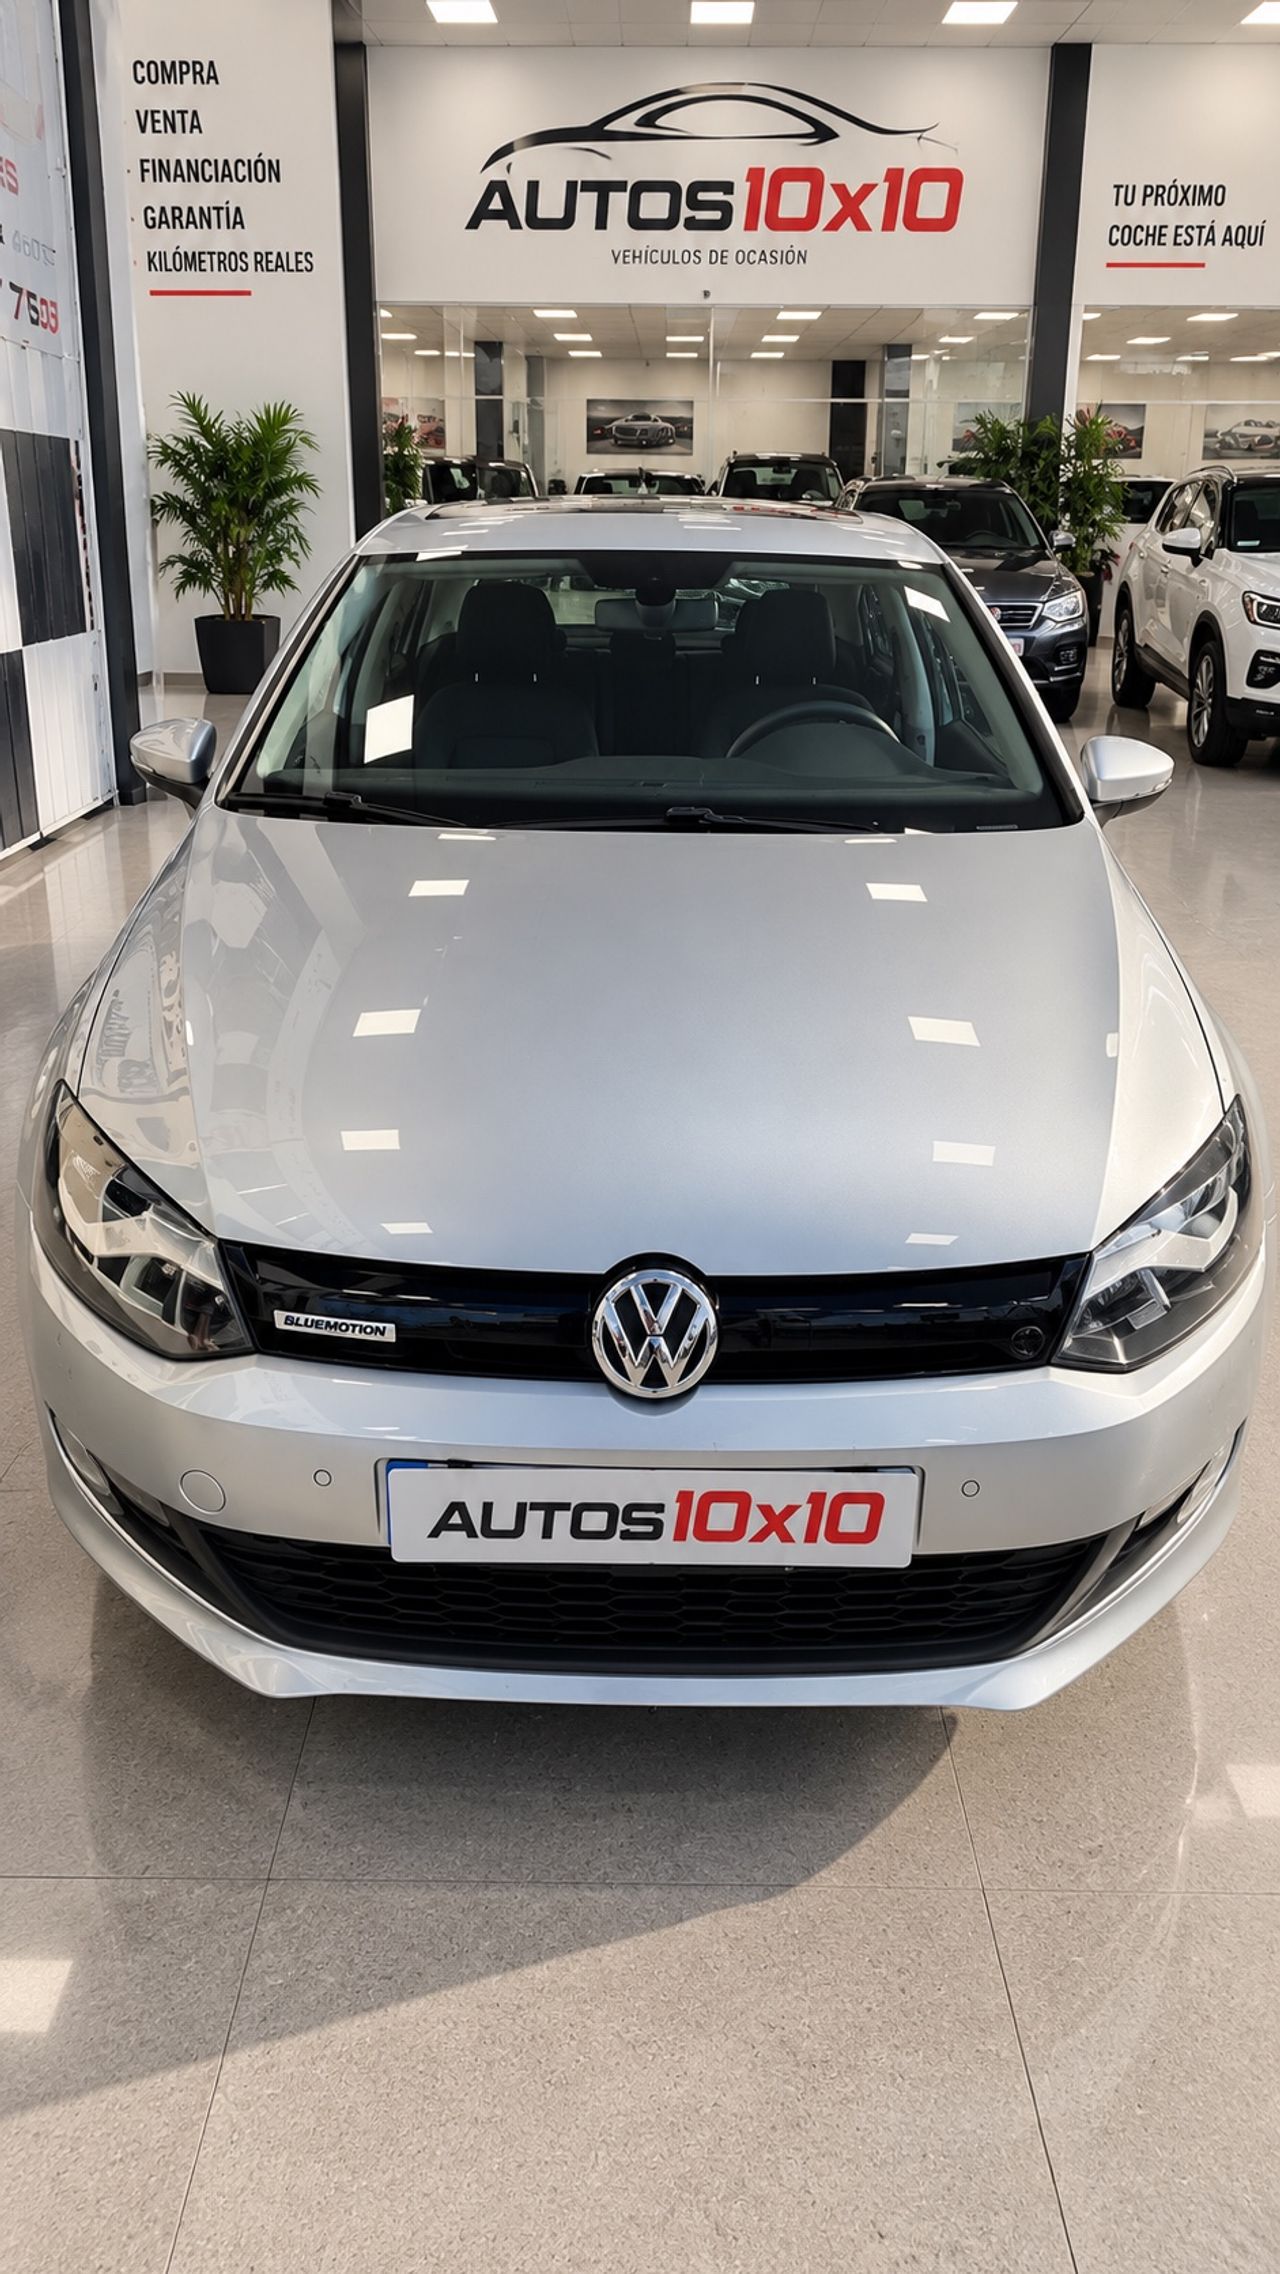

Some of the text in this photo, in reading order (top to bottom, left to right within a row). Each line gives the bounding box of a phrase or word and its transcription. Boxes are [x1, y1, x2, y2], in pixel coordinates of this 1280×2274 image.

[132, 60, 220, 86] COMPRA
[135, 109, 203, 135] VENTA
[139, 152, 281, 184] FINANCIACIÓN
[1113, 178, 1226, 207] TU PRÓXIMO
[143, 200, 245, 230] GARANTÍA
[1108, 219, 1267, 249] COCHE ESTÁ AQUÍ
[147, 245, 314, 273] KILÓMETROS REALES
[611, 245, 808, 265] VEHÍCULOS DE OCASIÓN
[283, 1315, 387, 1337] BLUEMOTION
